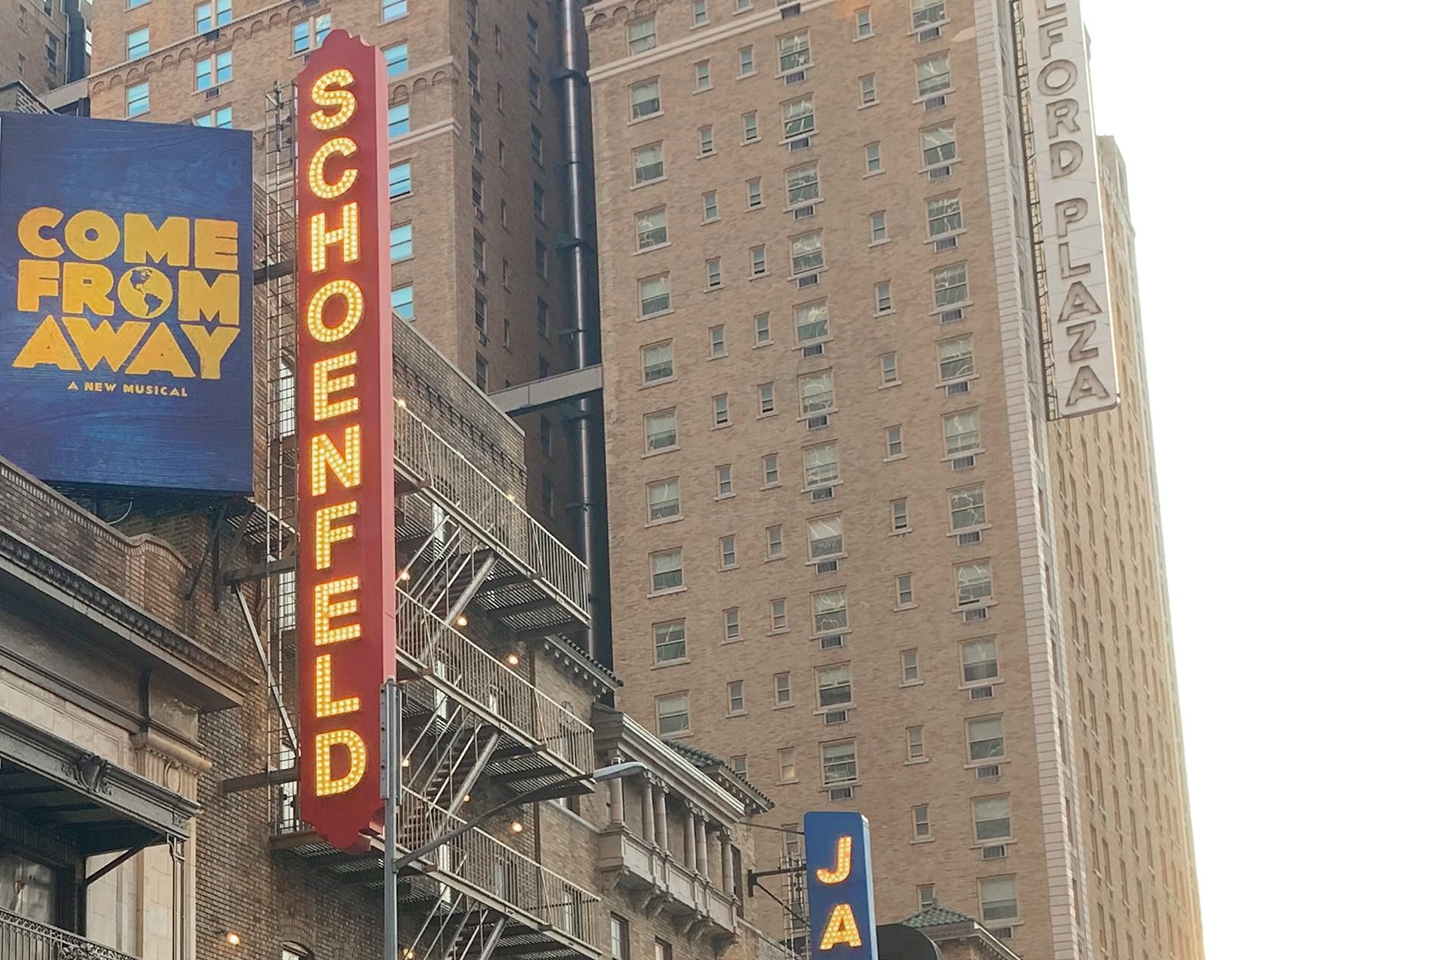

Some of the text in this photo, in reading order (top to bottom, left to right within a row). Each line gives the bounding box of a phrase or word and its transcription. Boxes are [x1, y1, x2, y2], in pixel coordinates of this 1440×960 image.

[17, 206, 239, 271] COME
[17, 259, 240, 327] FROM
[1056, 198, 1110, 408] PLAZA
[12, 315, 241, 379] AWAY
[67, 380, 188, 397] A NEW MUSICAL
[307, 68, 367, 797] SCHOENFELD
